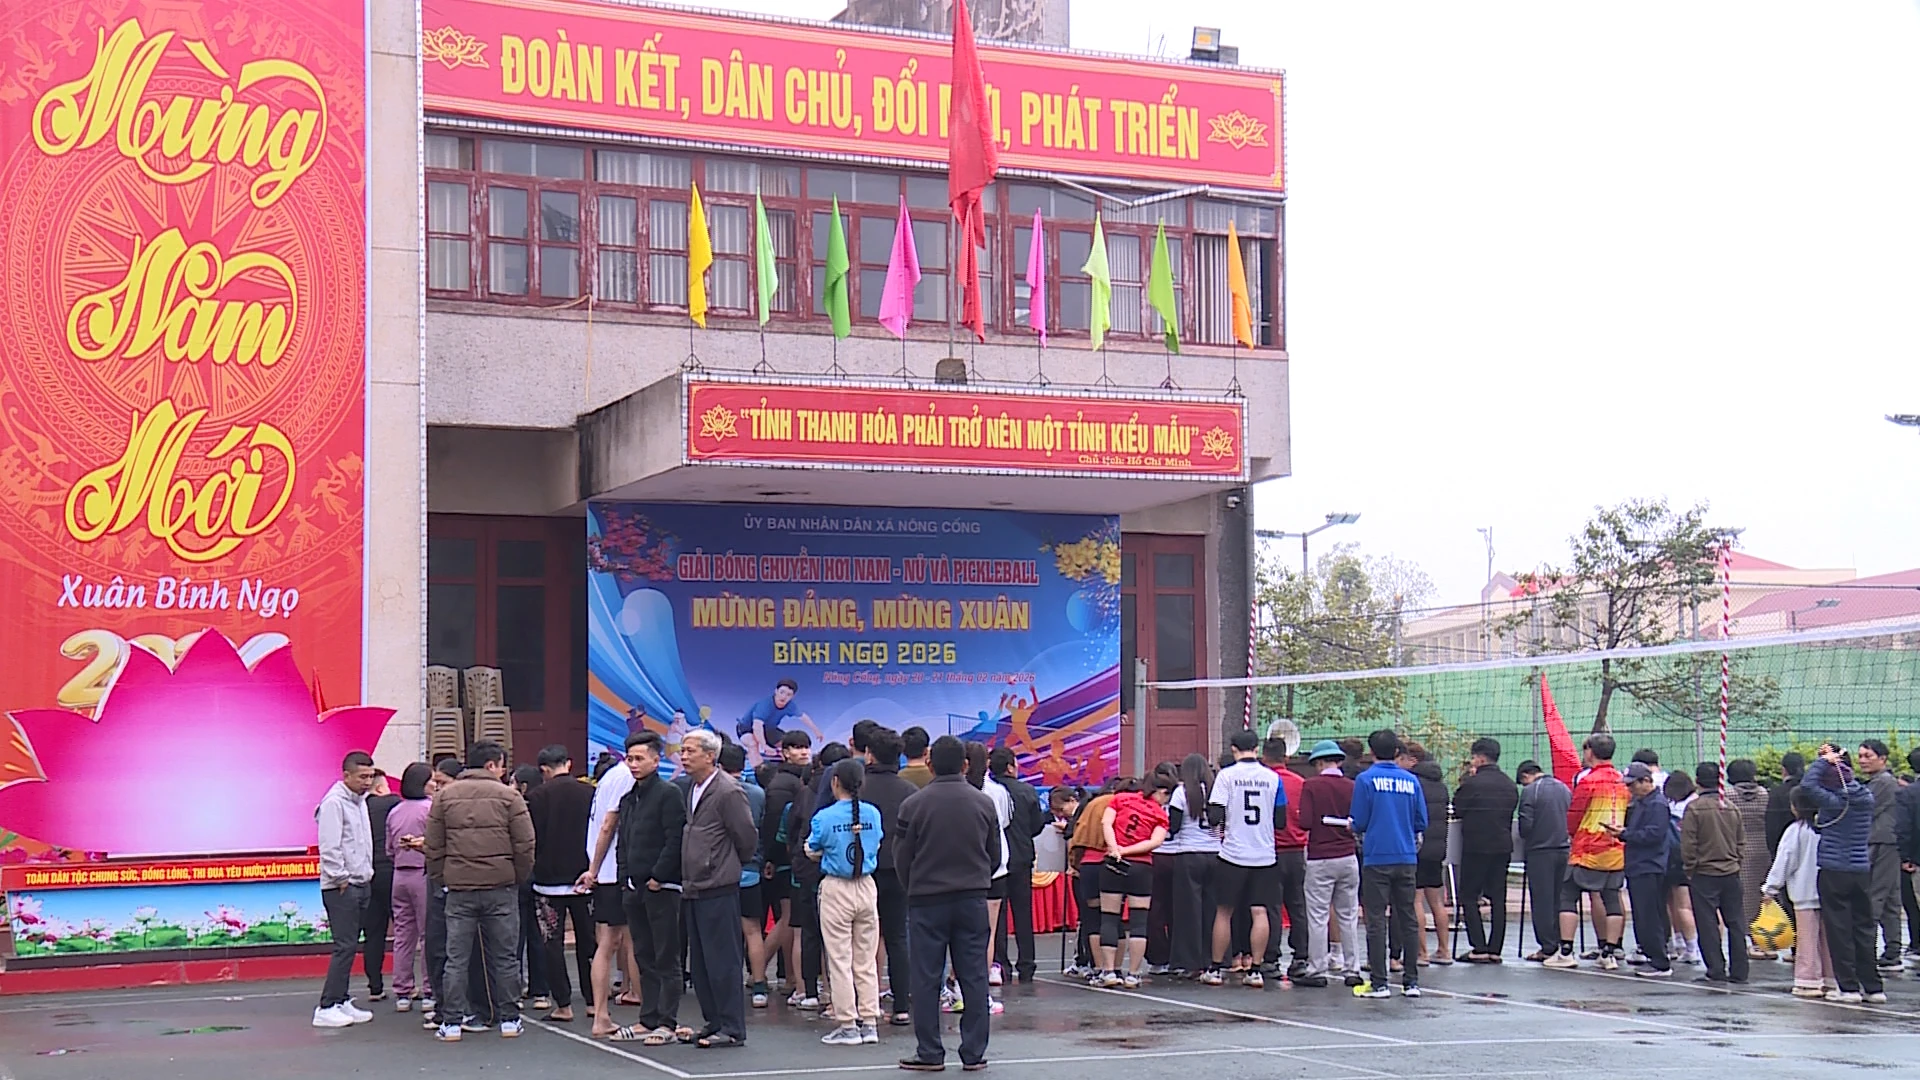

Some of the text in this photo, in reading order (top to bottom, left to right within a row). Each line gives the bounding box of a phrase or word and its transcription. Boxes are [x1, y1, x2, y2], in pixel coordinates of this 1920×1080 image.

[32, 16, 328, 209] Mừng
[501, 28, 603, 104] ĐOÀN
[615, 32, 691, 120] KẾT,
[702, 49, 774, 121] DÂN
[785, 48, 863, 137] CHỦ,
[872, 57, 928, 136] ĐỔI
[1021, 84, 1103, 152] PHÁT
[1110, 82, 1200, 160] TRIỂN
[66, 227, 299, 367] Năm
[796, 409, 857, 443] THANH
[862, 406, 898, 445] HÓA
[903, 402, 945, 447] PHẢI
[948, 404, 983, 448] TRỞ
[986, 412, 1022, 449] NÊN
[1027, 414, 1064, 457] MỘT
[1068, 411, 1107, 452] TỈNH
[1111, 412, 1149, 454] KIỂU
[64, 398, 297, 562] Mới
[1165, 458, 1192, 467] Minh
[743, 512, 981, 534] ỦY BAN NHÂN DÂN XÃ NÔNG CỐNG
[678, 547, 711, 581] GIẢI
[713, 549, 757, 582] BÓNG
[760, 545, 820, 582] CHUYỀN
[823, 555, 851, 583] HƠI
[853, 556, 892, 583] NAM
[903, 553, 928, 584] NỮ
[929, 555, 951, 585] VÀ
[952, 557, 1040, 586] PICKLEBALL
[58, 574, 300, 619] Xuân Bính Ngọ
[692, 589, 1031, 634] MỪNG ĐẢNG, MỪNG XUÂN
[773, 637, 957, 669] BÍNH NGỌ 2026
[946, 670, 974, 687] tháng
[976, 671, 988, 684] 02
[1012, 671, 1036, 684] 2026
[1373, 777, 1415, 795] VIET NAM
[1244, 790, 1260, 825] 5
[25, 870, 49, 885] TOÀN
[51, 869, 69, 884] DÂN
[71, 869, 88, 886] TỘC
[89, 869, 119, 883] CHUNG
[193, 867, 205, 879] THI
[207, 867, 224, 879] ĐUA
[226, 864, 241, 878] YÊU
[304, 861, 316, 875] VÀ
